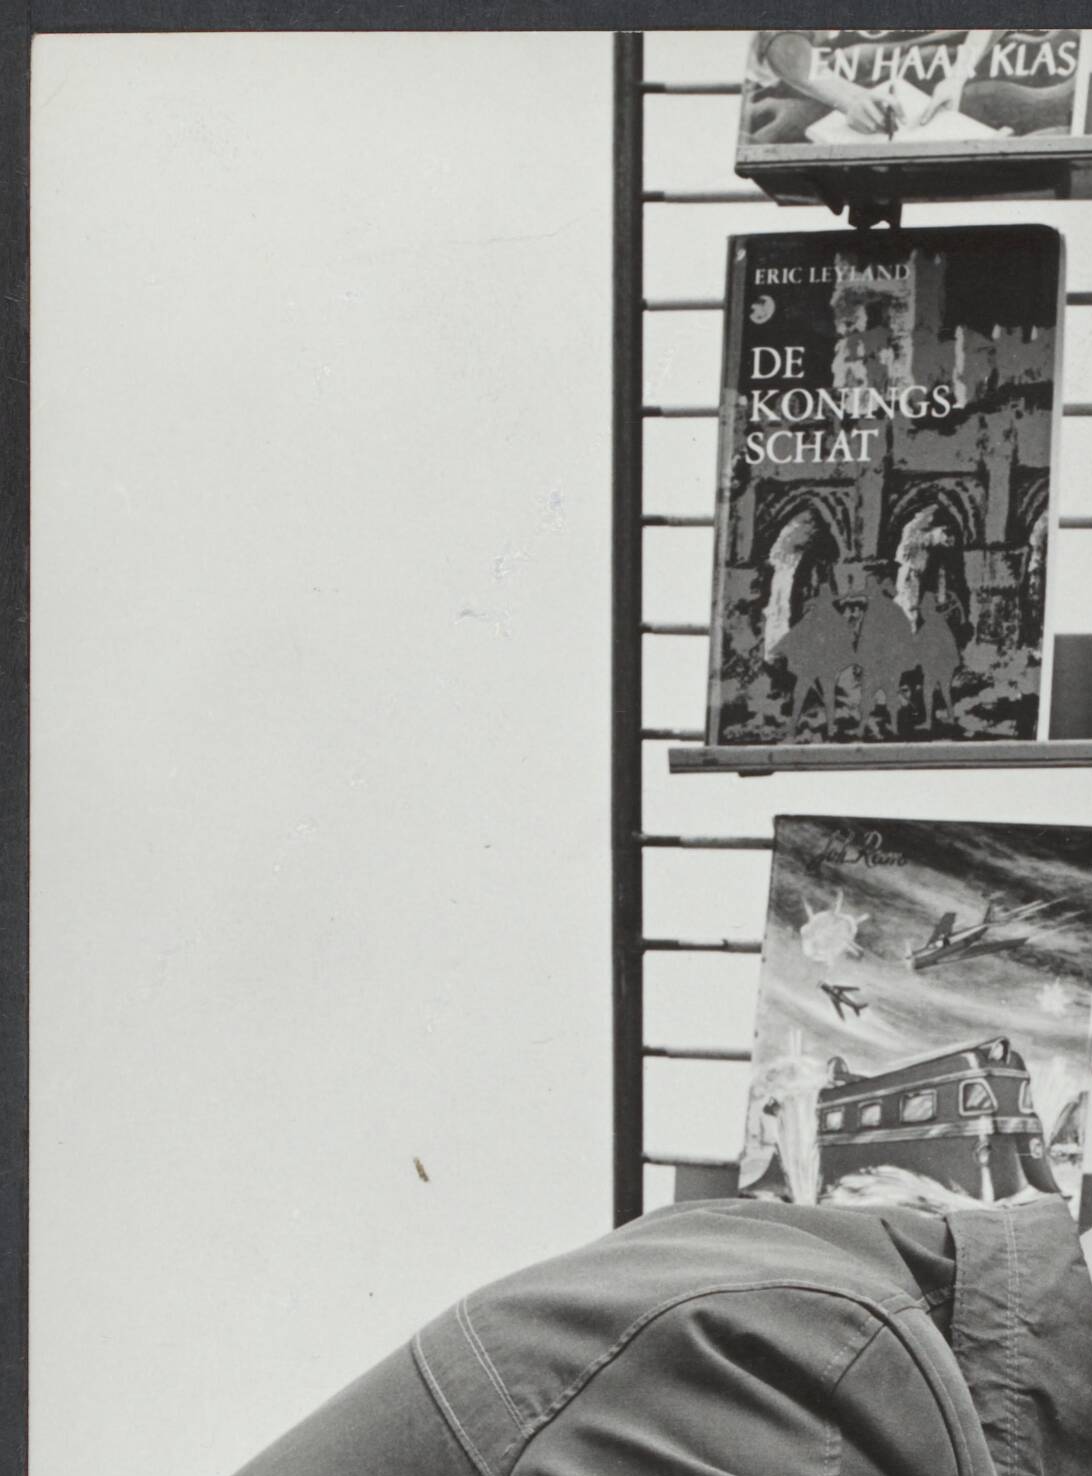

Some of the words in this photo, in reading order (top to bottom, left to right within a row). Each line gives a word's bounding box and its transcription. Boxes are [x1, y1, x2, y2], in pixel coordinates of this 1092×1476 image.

[808, 46, 860, 82] EN
[989, 41, 1077, 79] KLAS
[754, 266, 803, 286] ERIC
[809, 263, 911, 284] LEYLAND
[751, 346, 806, 380] DE
[745, 429, 880, 465] SCHAT
